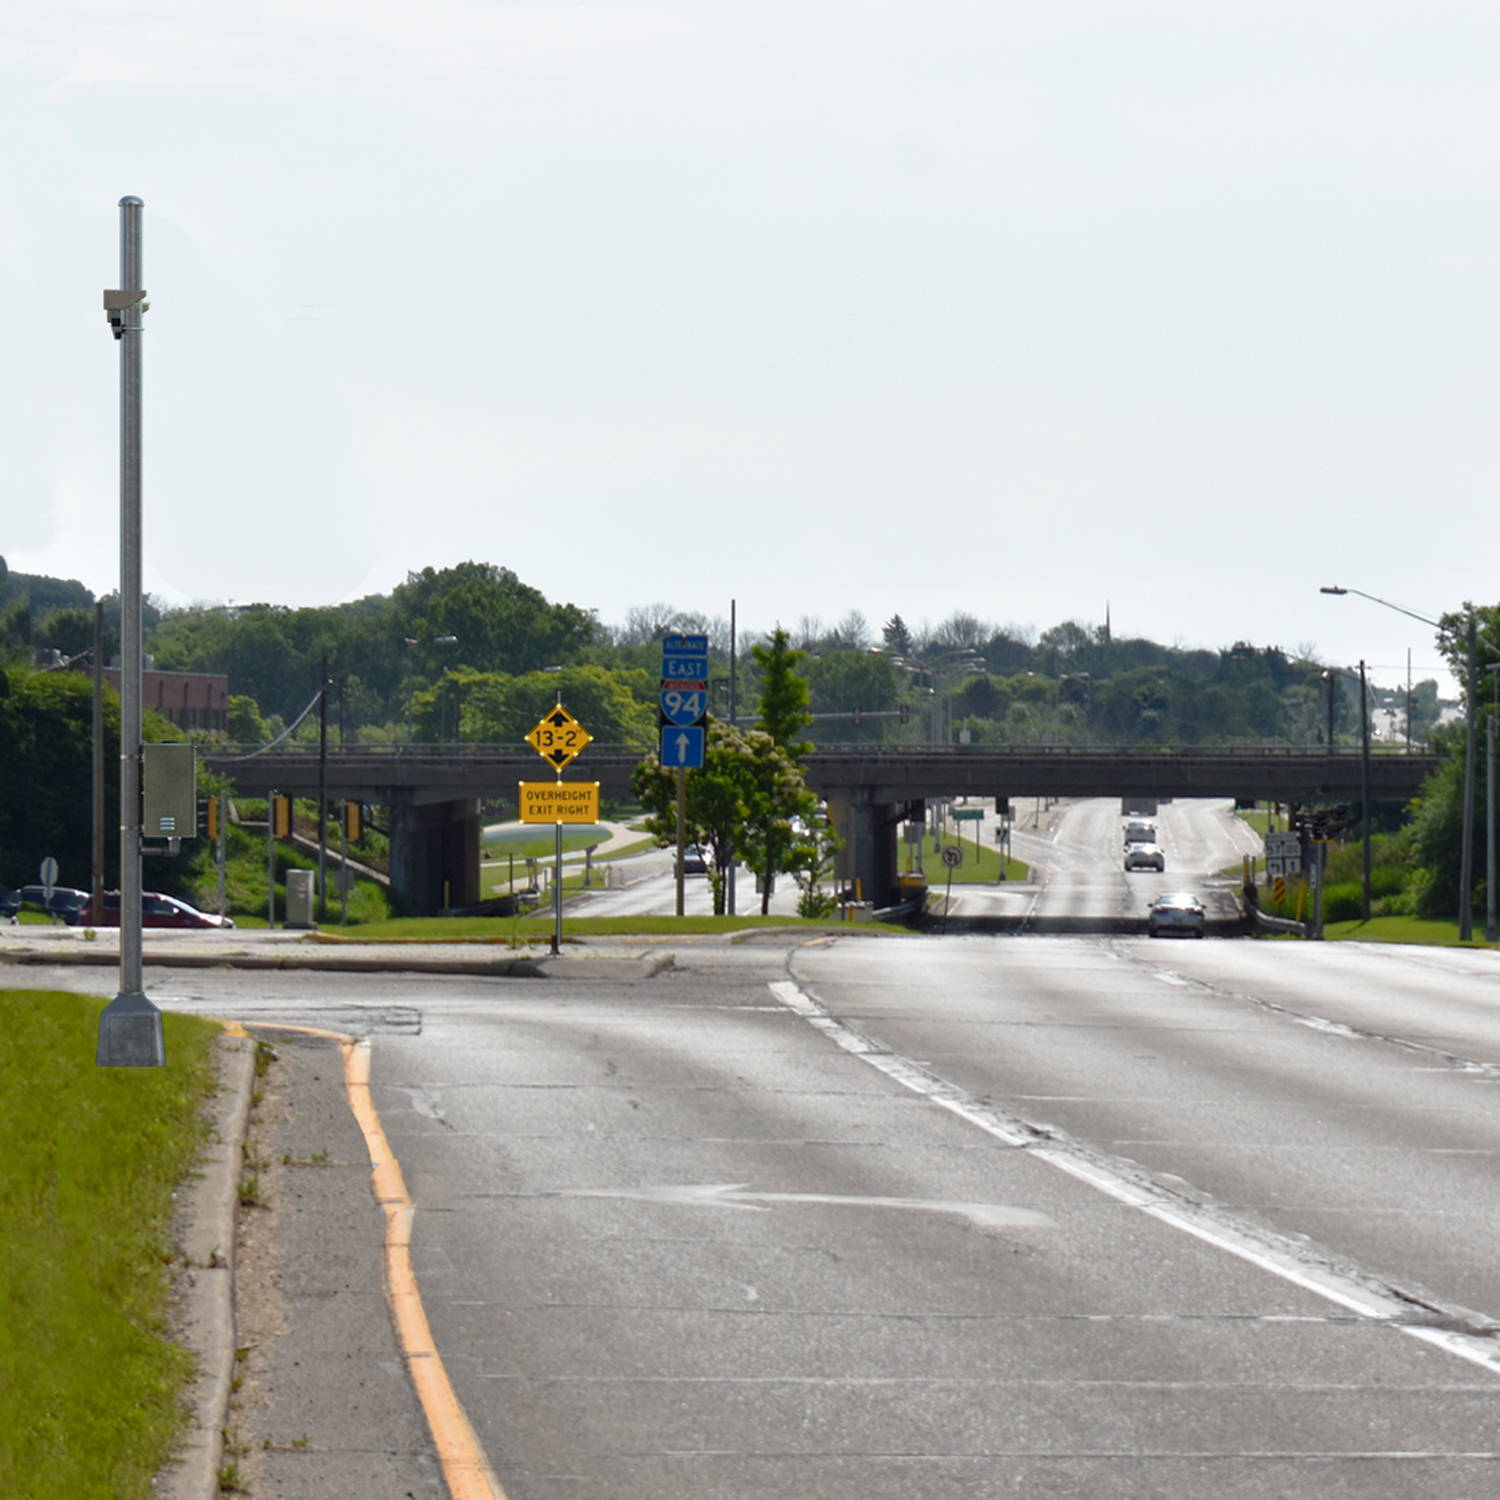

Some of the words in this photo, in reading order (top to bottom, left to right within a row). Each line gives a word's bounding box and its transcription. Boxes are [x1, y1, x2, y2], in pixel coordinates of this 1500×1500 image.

[668, 661, 702, 676] EAST
[665, 692, 700, 716] 94
[526, 791, 592, 801] OVERHEIGHT
[529, 805, 553, 815] EXIT
[557, 805, 589, 815] RIGHT
